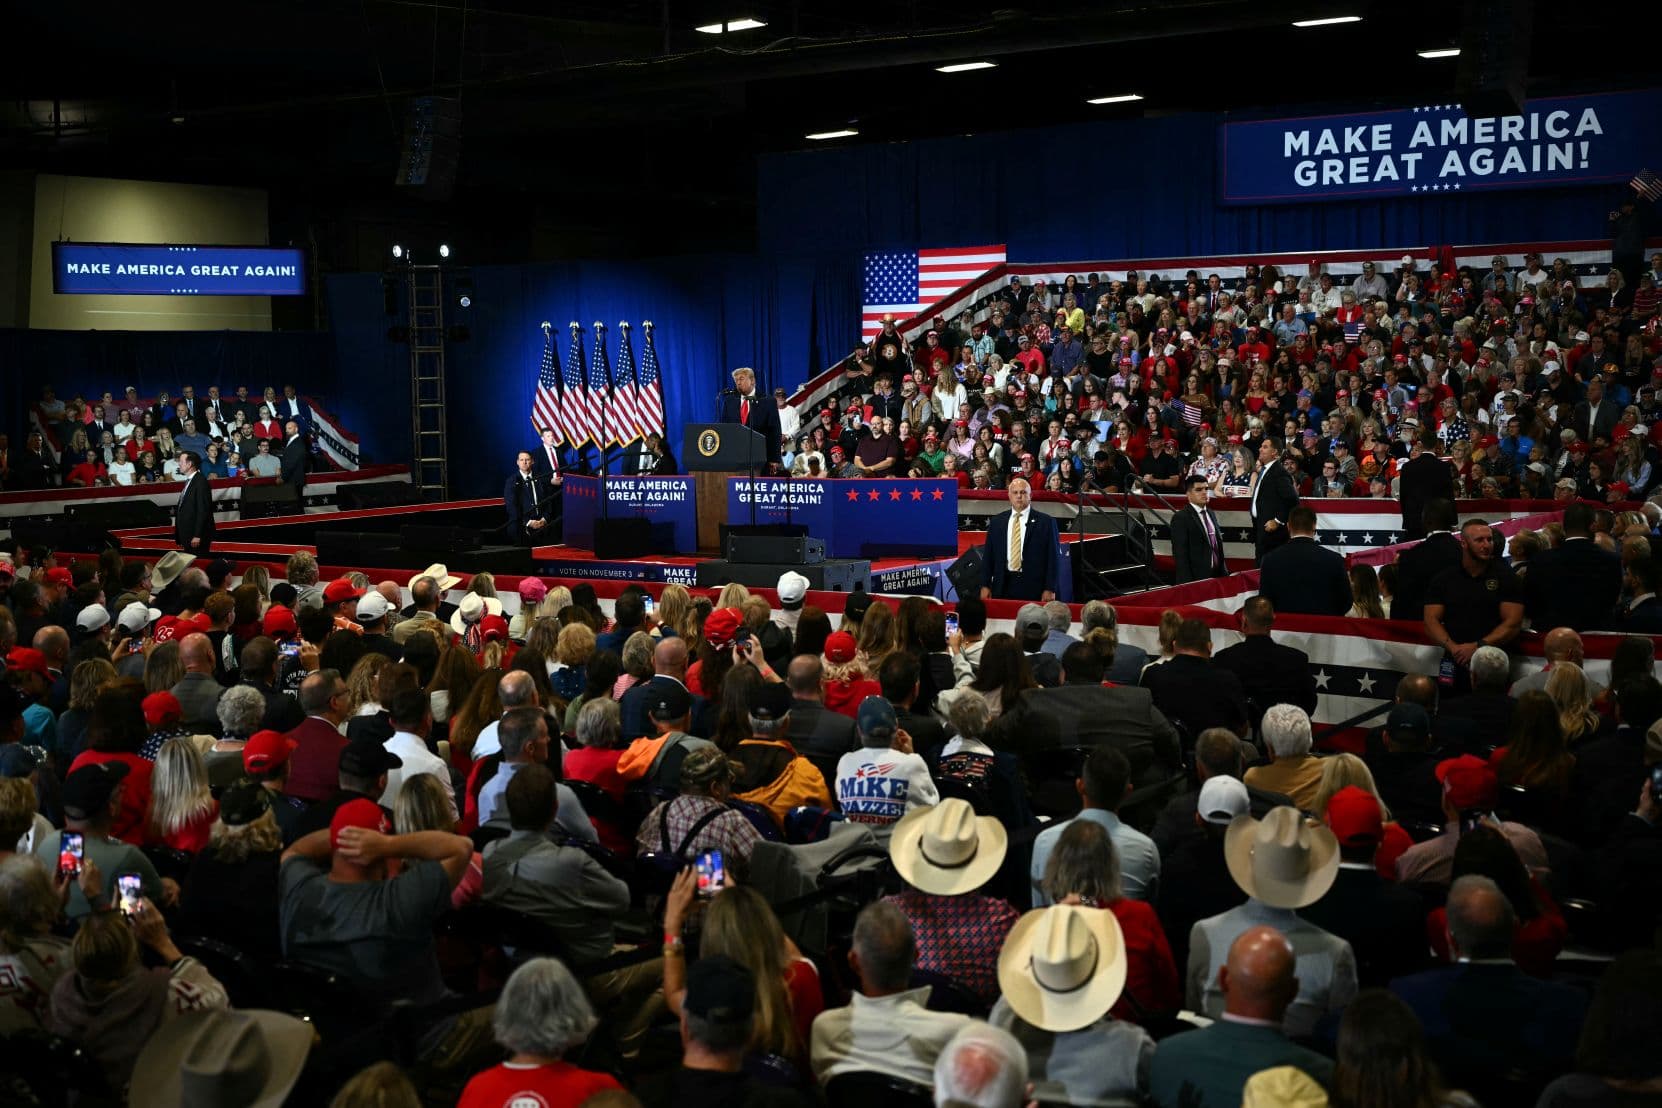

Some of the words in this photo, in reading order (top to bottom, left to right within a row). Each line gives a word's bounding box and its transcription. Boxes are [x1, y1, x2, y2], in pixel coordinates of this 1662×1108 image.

[1283, 123, 1393, 157] MAKE
[1409, 107, 1603, 148] AMERICA
[1294, 152, 1423, 187] GREAT
[1438, 141, 1590, 177] AGAIN!
[67, 263, 111, 274] MAKE
[116, 264, 185, 276] AMERICA
[191, 265, 239, 276] GREAT
[244, 266, 296, 277] AGAIN!
[606, 481, 635, 490] MAKE
[638, 481, 688, 490] AMERICA
[735, 481, 768, 492] MAKE
[771, 483, 825, 494] AMERICA
[608, 491, 643, 501] GREAT
[646, 491, 685, 501] AGAIN!
[780, 495, 822, 505] AGAIN!
[578, 568, 589, 576] ON
[589, 569, 627, 578] NOVEMBER
[628, 570, 633, 578] 3
[663, 568, 691, 577] MAKE
[881, 572, 900, 583] MAKE
[901, 567, 932, 580] AMERICA
[883, 580, 905, 592] GREAT
[906, 576, 930, 588] AGAIN!
